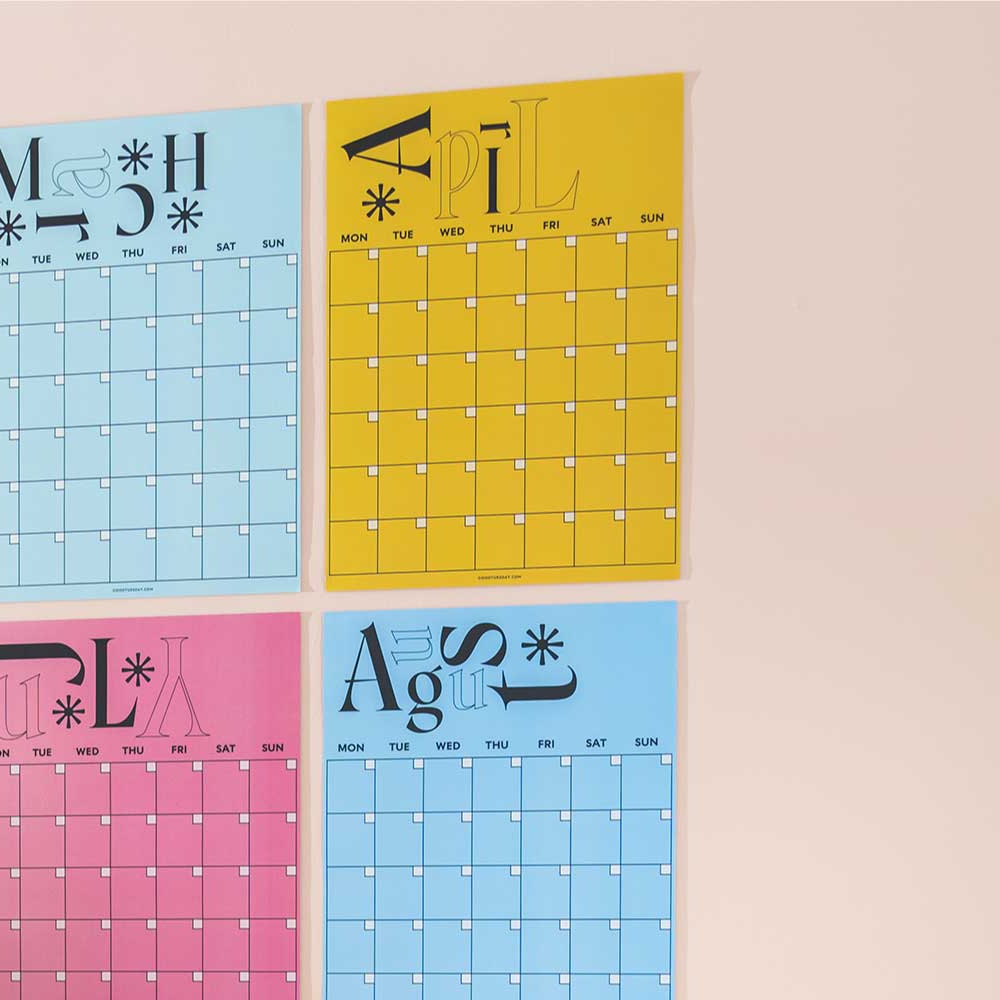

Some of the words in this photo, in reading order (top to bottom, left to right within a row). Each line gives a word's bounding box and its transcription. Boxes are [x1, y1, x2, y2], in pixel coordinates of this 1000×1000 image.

[341, 233, 368, 244] MON
[392, 229, 414, 240] TUE
[439, 226, 465, 237] WED
[489, 223, 514, 234] THU
[543, 220, 560, 230] FRI
[591, 216, 613, 227] SAT
[640, 212, 664, 224] SUN
[31, 254, 51, 265] TUE
[75, 251, 99, 261] WED
[121, 248, 144, 258] THU
[171, 245, 188, 255] FRI
[216, 241, 236, 252] SAT
[262, 238, 285, 249] SUN
[32, 747, 52, 757] TUE
[75, 746, 100, 756] WED
[121, 746, 144, 755] THU
[171, 744, 187, 754] FRI
[216, 743, 236, 754] SAT
[261, 743, 284, 753] SUN
[337, 743, 365, 753] MON
[388, 742, 410, 752] TUE
[435, 741, 461, 751] WED
[485, 740, 509, 750] THU
[538, 739, 555, 749] FRI
[585, 738, 607, 748] SAT
[634, 737, 659, 747] SUN
